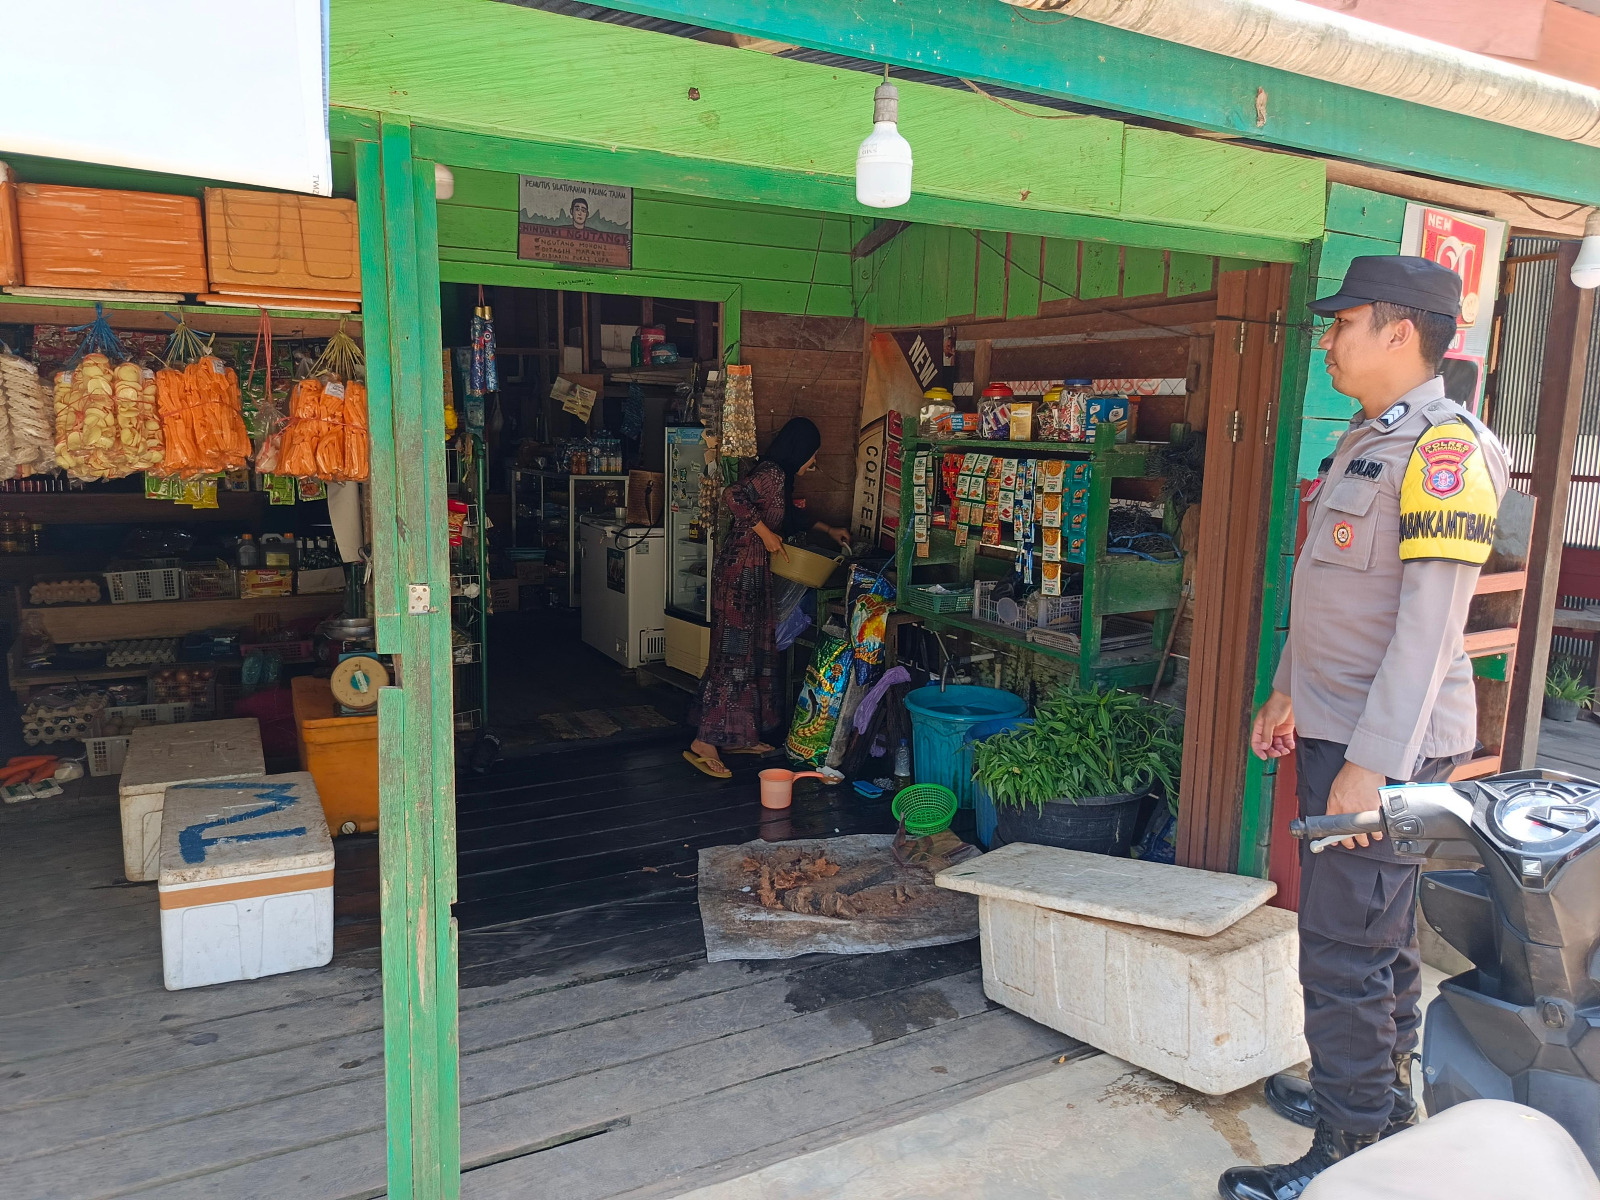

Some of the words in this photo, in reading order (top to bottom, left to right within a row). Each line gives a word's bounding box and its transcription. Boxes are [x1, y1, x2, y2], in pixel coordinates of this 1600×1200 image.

[525, 179, 551, 190] PEMUTUS
[588, 187, 608, 198] PALING
[608, 190, 627, 200] TAJAM
[1427, 212, 1452, 232] NEW
[540, 238, 575, 248] NGUTANG
[908, 334, 938, 388] NEW
[1424, 441, 1470, 453] POLRES
[859, 445, 879, 540] COFFEE
